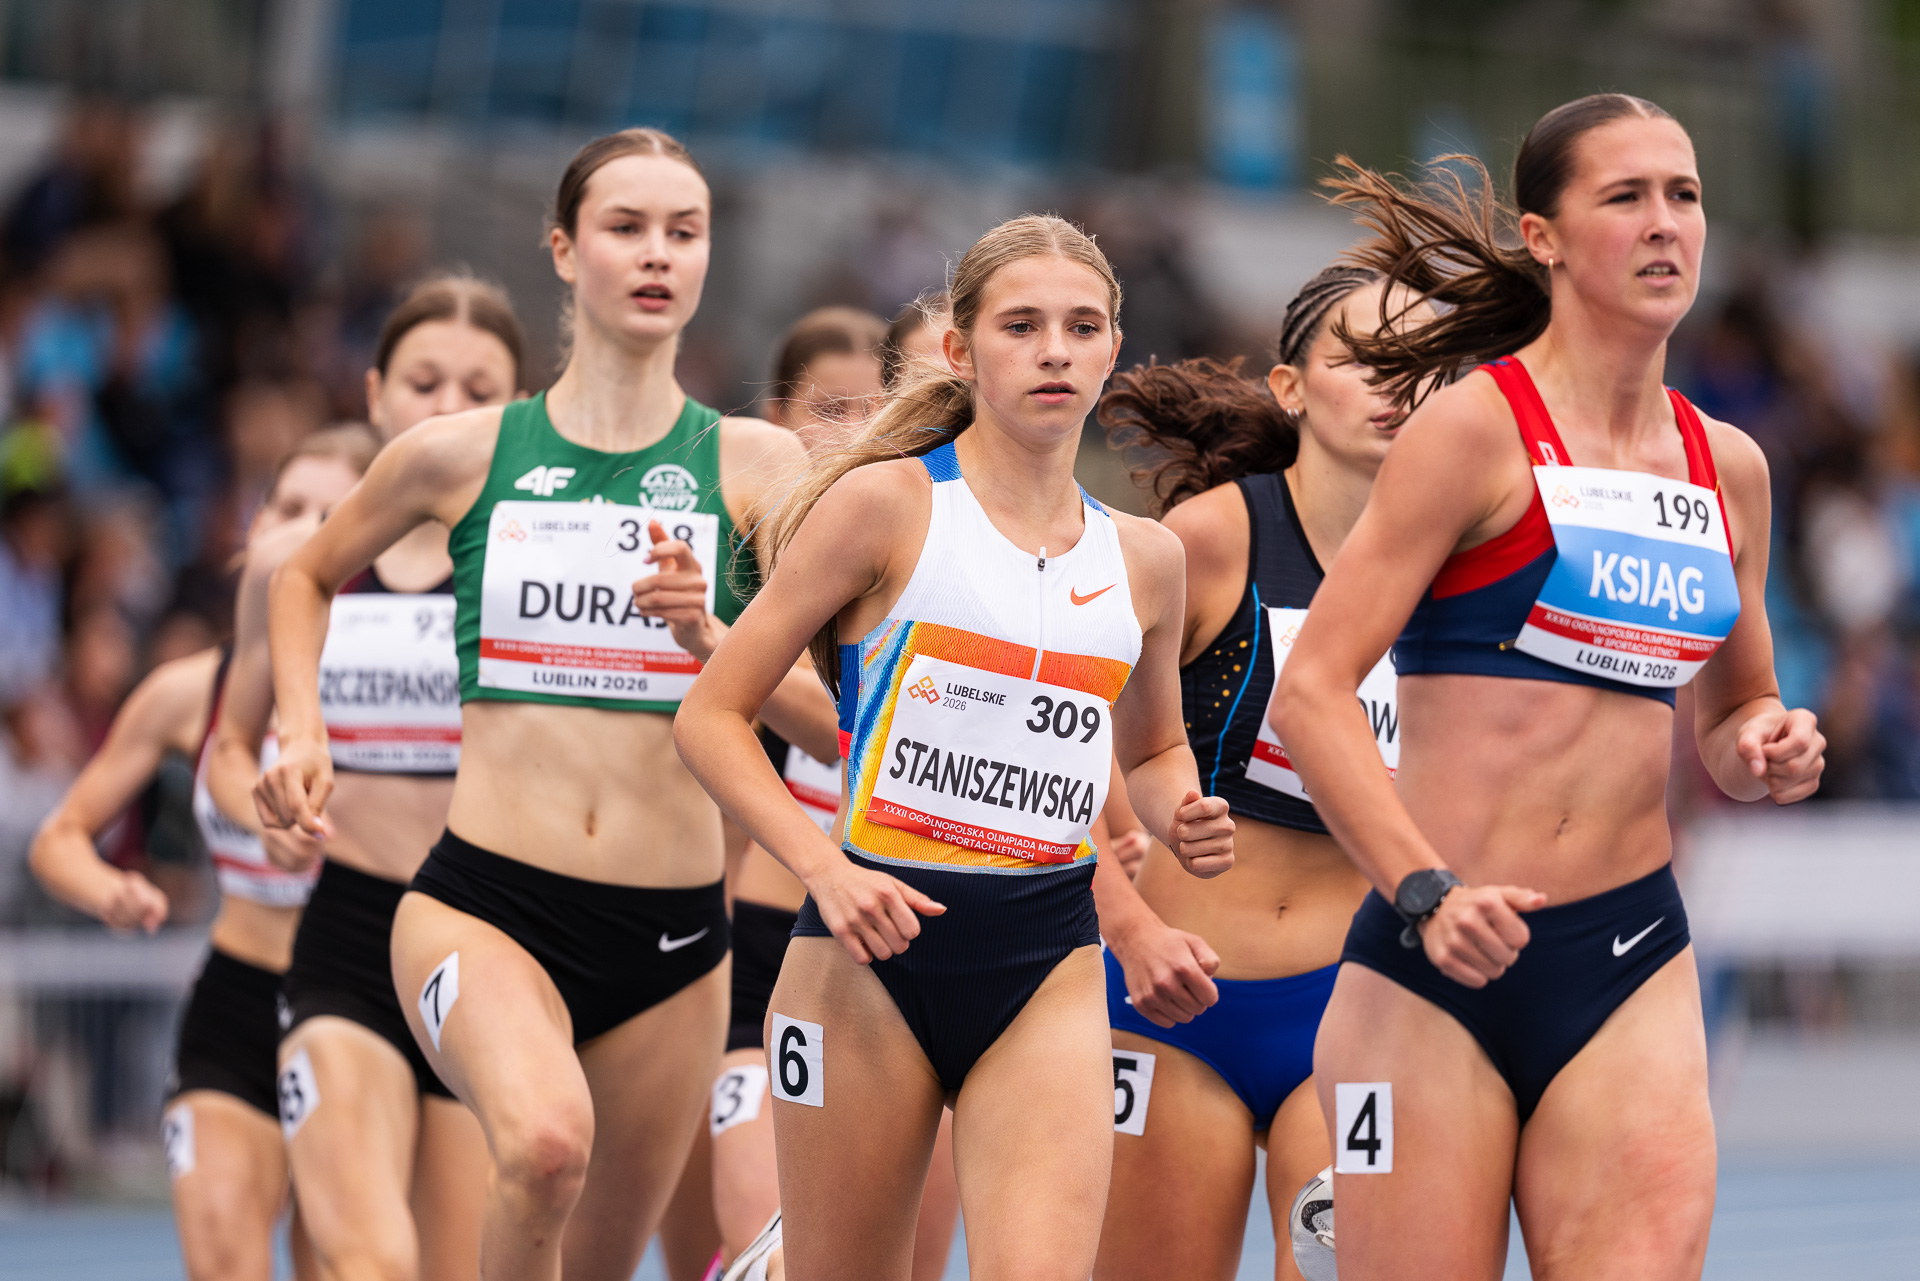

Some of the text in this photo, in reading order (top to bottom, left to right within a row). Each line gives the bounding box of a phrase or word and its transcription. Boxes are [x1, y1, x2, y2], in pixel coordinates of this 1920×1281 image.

[515, 465, 576, 496] 4F
[1580, 486, 1633, 502] LUBELSKIE
[532, 520, 591, 533] LUBELSKIE
[1653, 491, 1710, 534] 199
[618, 519, 694, 552] 38
[1588, 550, 1706, 622] KSIĄG
[1571, 619, 1640, 641] OGÓLNOPOLSKA
[1641, 633, 1681, 648] OLIMPIADA
[1593, 635, 1681, 658] W SPORTACH LETNICH
[533, 670, 649, 692] LUBLIN 2026
[1576, 649, 1678, 681] LUBLIN 2026
[942, 696, 967, 711] 2026
[945, 682, 1007, 706] LUBELSKIE
[1025, 694, 1101, 744] 309
[889, 737, 1096, 825] STANISZEWSKA
[882, 803, 1073, 856] XXXII OGÓLNOPOLSKA OLIMPIADA MŁODZIEŻY
[932, 829, 1036, 861] W SPORTACH LETNICH
[424, 967, 445, 1028] 7
[778, 1025, 809, 1097] 6
[717, 1074, 745, 1124] 3
[1112, 1056, 1138, 1125] 5
[1347, 1091, 1382, 1166] 4
